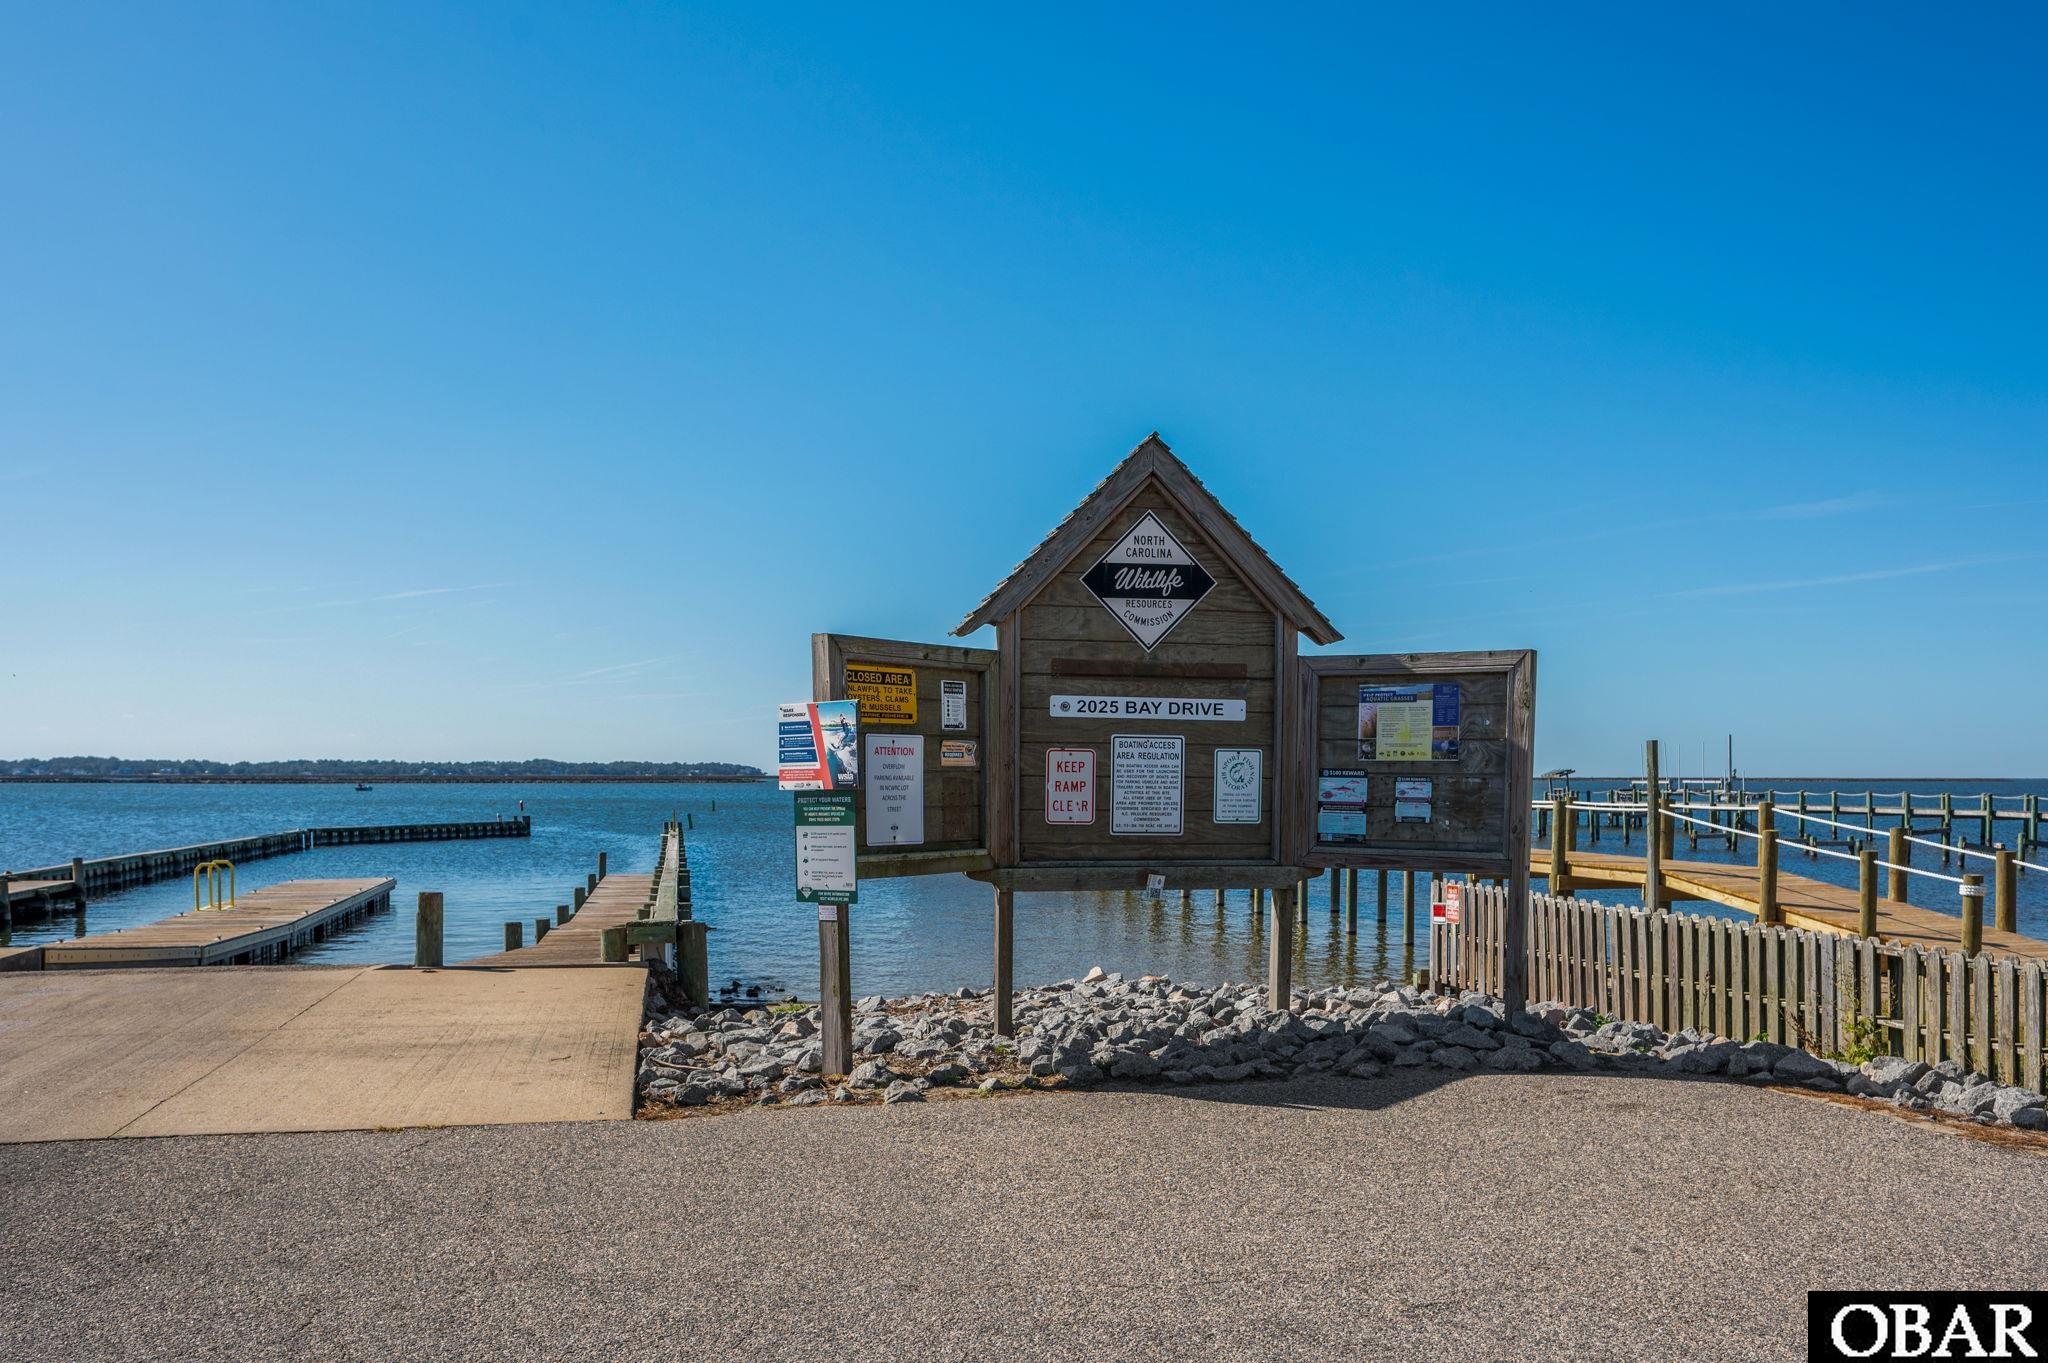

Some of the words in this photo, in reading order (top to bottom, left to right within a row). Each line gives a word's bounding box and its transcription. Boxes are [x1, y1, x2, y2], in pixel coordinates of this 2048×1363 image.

[1134, 536, 1165, 546] NORTH
[1126, 548, 1172, 559] CAROLINA
[1115, 567, 1184, 597] Wildlife
[1126, 600, 1172, 609] RESOURCES
[1123, 610, 1175, 626] COMMISSION
[847, 671, 882, 683] CLOSED
[885, 674, 909, 685] AREA
[847, 684, 881, 693] NLAWFUL
[886, 695, 909, 703] CLAMS
[870, 703, 902, 712] MUSSELS
[1077, 700, 1119, 713] 2025
[1125, 701, 1162, 714] BAY
[1168, 703, 1224, 716] DRIVE
[1119, 740, 1148, 749] BOATING
[1149, 741, 1176, 750] ACCESS
[874, 746, 915, 756] ATTENTION
[1116, 752, 1135, 760] AREA
[1138, 753, 1180, 761] REGULATION
[1056, 761, 1085, 774] KEEP
[1222, 755, 1240, 770] SPORT
[1243, 756, 1255, 771] FISH
[1221, 771, 1256, 791] RESTORATION
[1054, 781, 1087, 793] RAMP
